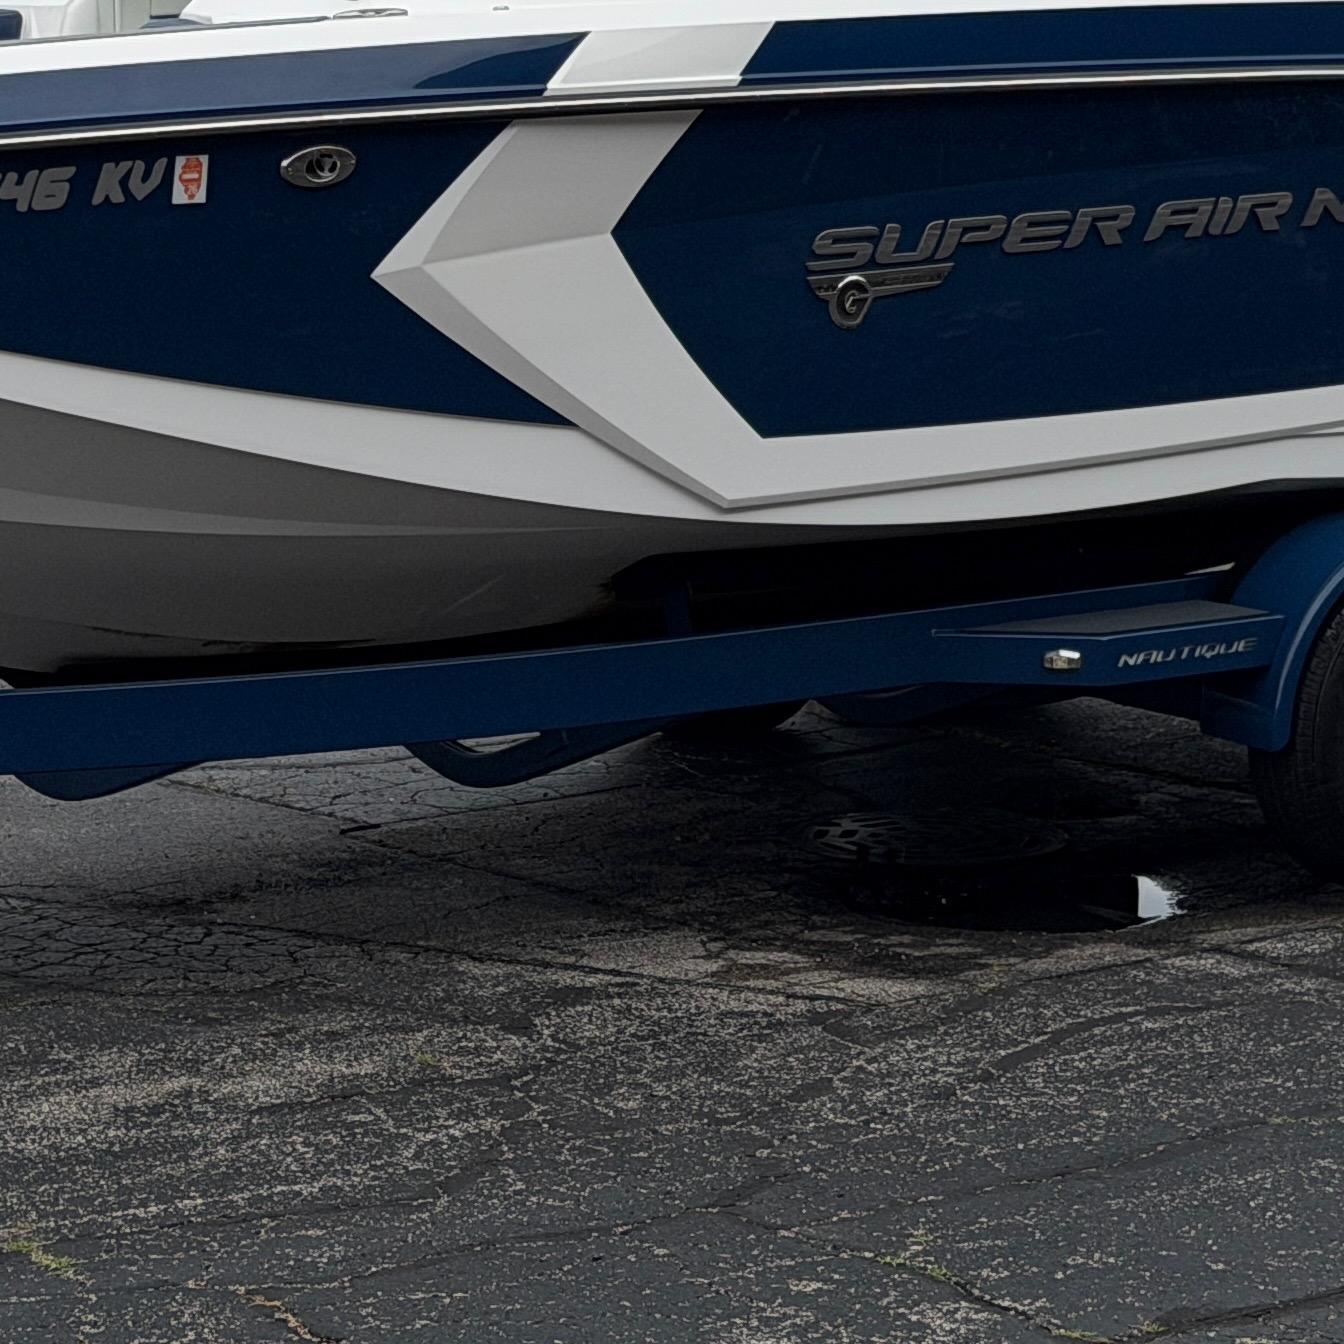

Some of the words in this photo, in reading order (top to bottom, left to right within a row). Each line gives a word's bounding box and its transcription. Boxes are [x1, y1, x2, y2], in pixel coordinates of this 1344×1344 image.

[92, 157, 169, 205] KV
[806, 205, 1136, 270] SUPER
[1143, 191, 1294, 242] AIR
[1117, 638, 1258, 668] NAUTIQUE
